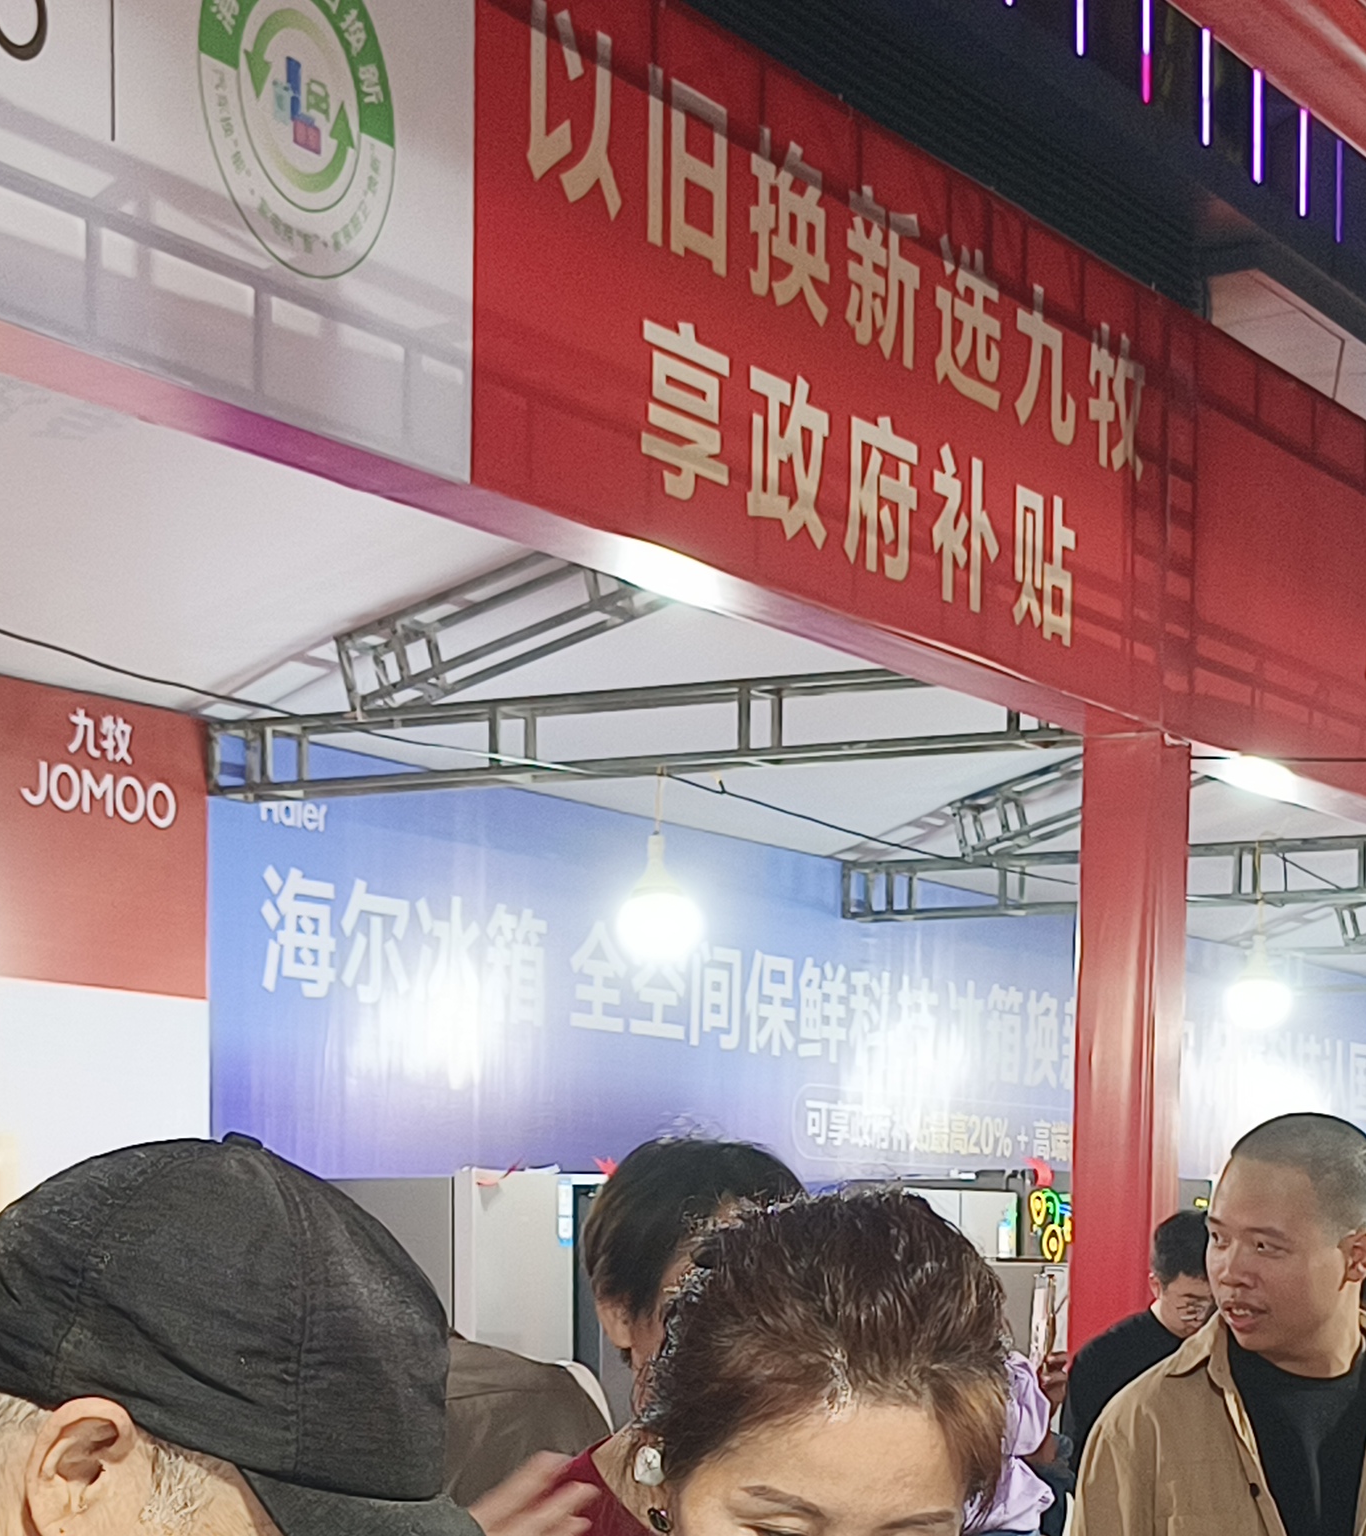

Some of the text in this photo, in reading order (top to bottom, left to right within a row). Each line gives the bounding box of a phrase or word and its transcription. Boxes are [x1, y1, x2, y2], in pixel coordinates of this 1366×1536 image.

[527, 4, 1145, 481] 以旧换新选九牧
[640, 318, 1077, 647] 享政府补贴
[20, 761, 177, 829] JOMOO
[67, 707, 133, 764] 九牧
[260, 864, 548, 1027] 海尔冰箱
